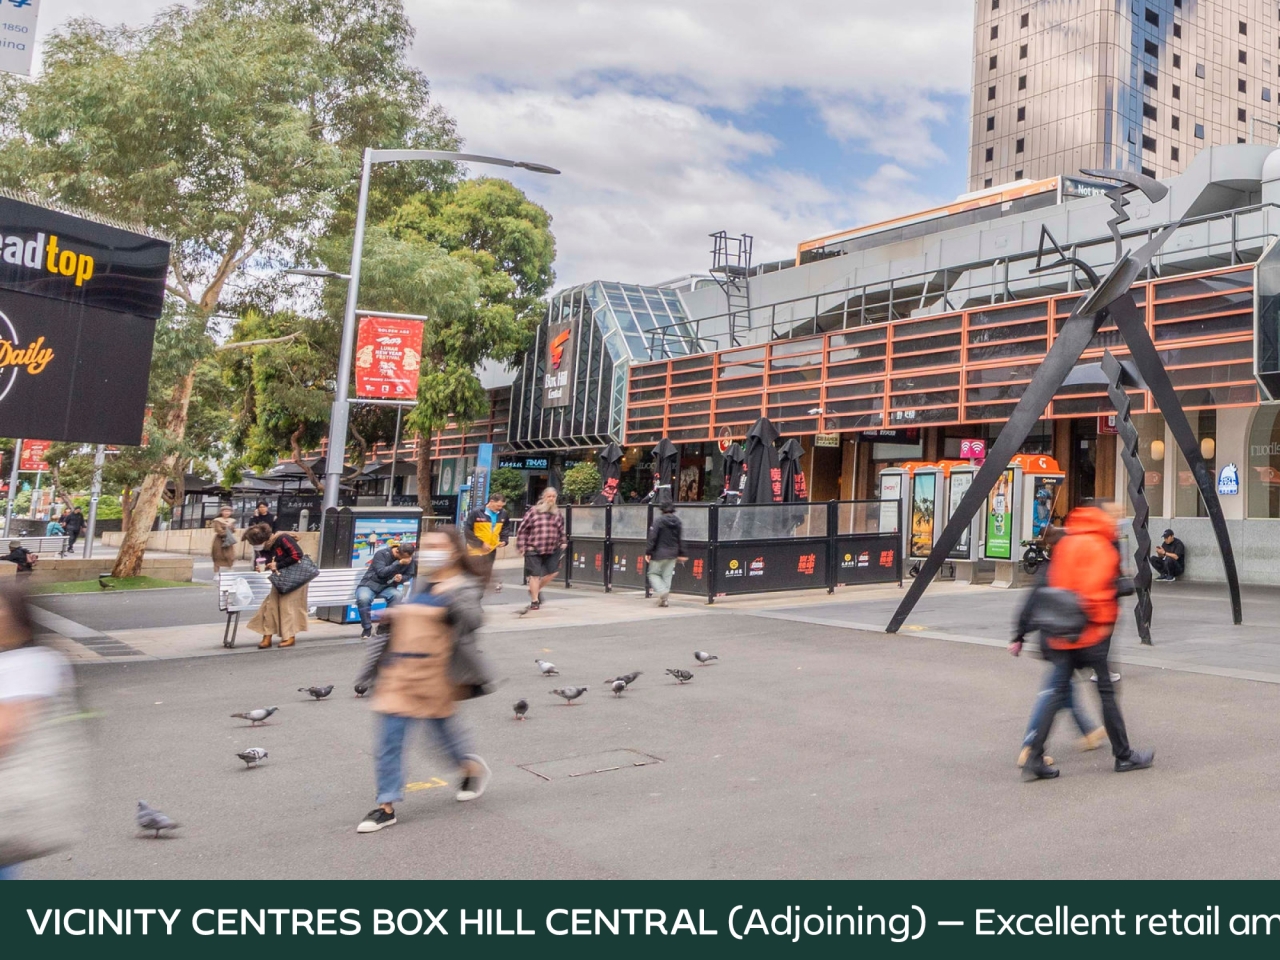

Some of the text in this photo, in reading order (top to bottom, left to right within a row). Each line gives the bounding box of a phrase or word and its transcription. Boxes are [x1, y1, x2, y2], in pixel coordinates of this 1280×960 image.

[2, 22, 29, 34] 1850
[1078, 184, 1091, 196] Not
[0, 336, 54, 375] Daily
[431, 499, 449, 507] INA'S
